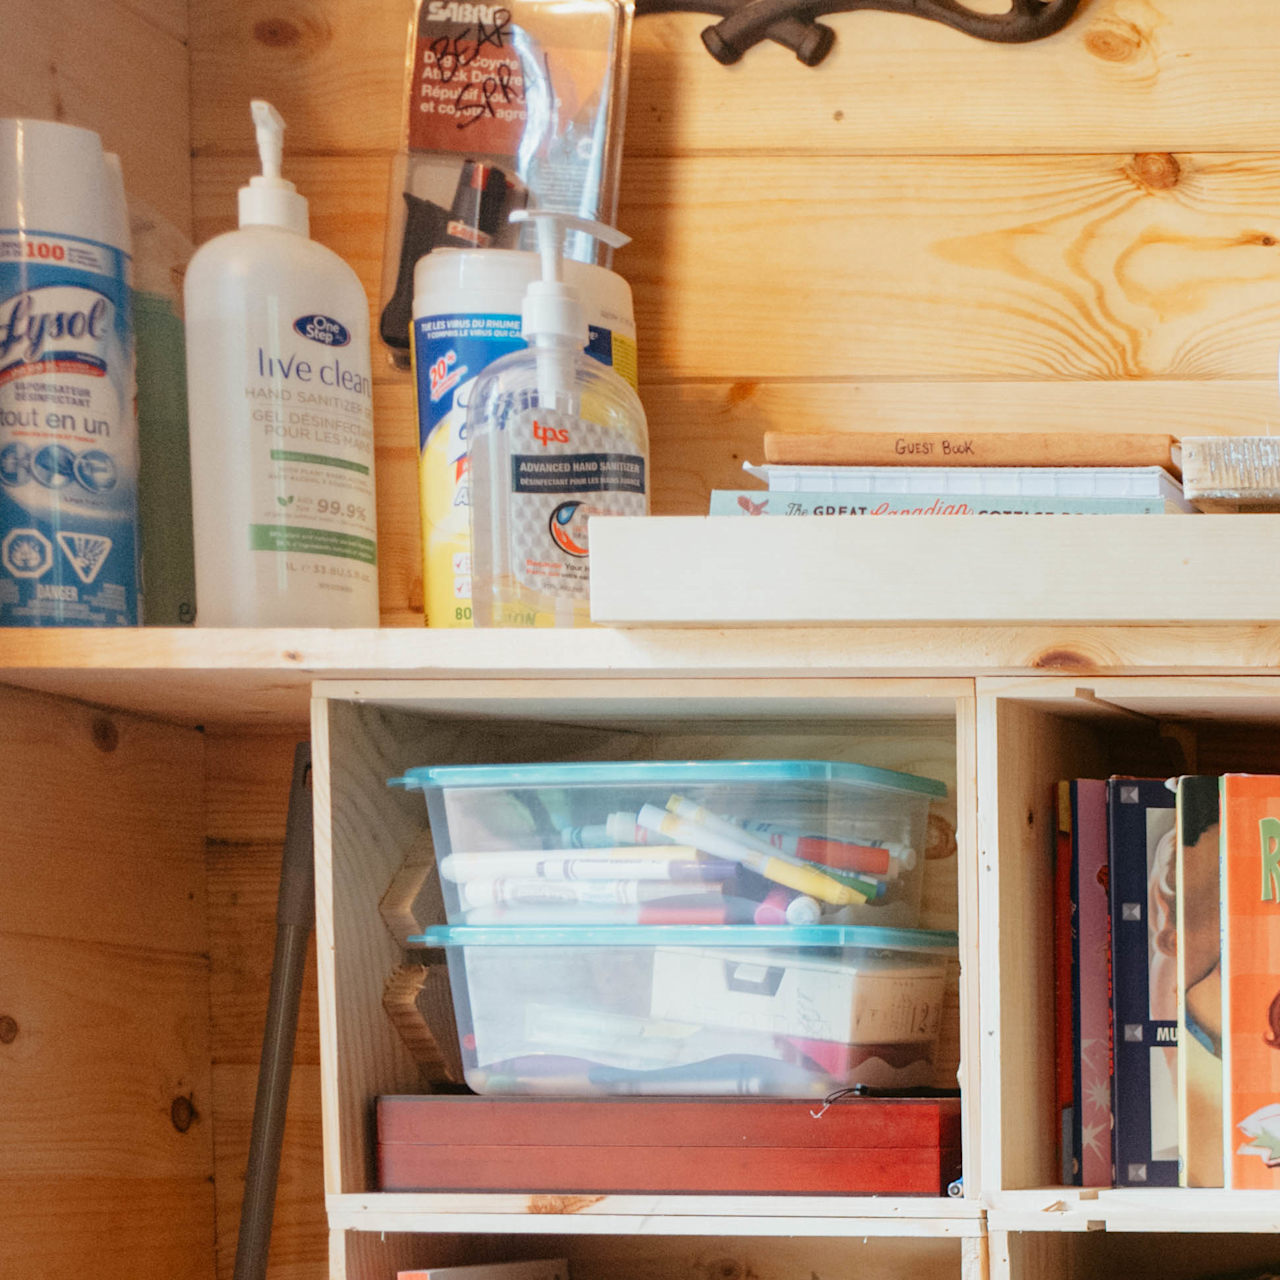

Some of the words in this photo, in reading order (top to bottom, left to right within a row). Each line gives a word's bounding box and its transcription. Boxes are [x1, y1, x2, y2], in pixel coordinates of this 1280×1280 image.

[429, 8, 513, 83] BEAR
[27, 242, 65, 260] 100
[313, 316, 340, 333] One
[447, 319, 470, 329] VIRUS
[472, 319, 485, 328] DU
[486, 320, 521, 329] RHUME
[306, 324, 334, 344] Step
[259, 347, 312, 382] live
[320, 359, 372, 398] clean
[245, 387, 292, 401] HAND
[45, 412, 76, 428] en
[84, 417, 110, 436] un
[252, 409, 281, 422] GEL
[264, 425, 310, 440] POUR
[315, 431, 340, 444] LES
[533, 420, 570, 446] tps
[520, 462, 570, 473] ADVANCED
[572, 461, 598, 472] HAND
[600, 462, 641, 474] SANITIZER
[317, 498, 367, 521] 99.9%
